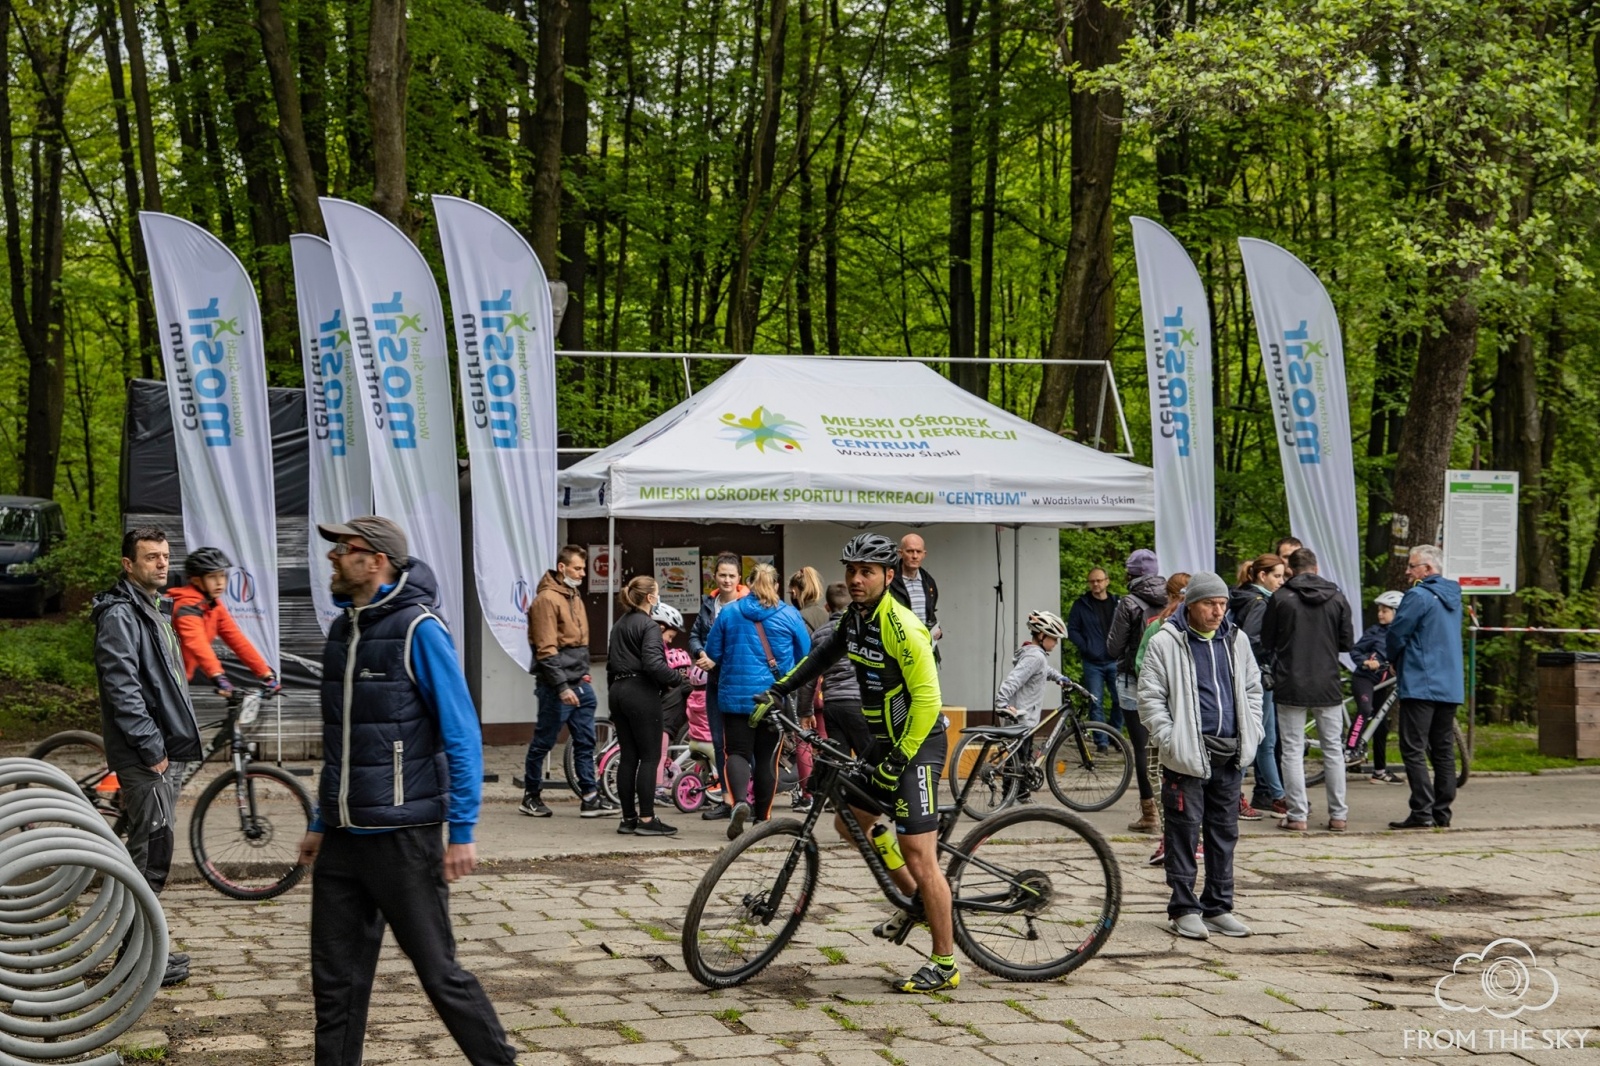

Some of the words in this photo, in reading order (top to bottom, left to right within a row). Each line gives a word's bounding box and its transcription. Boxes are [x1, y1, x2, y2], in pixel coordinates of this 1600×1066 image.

[820, 414, 896, 429] MIEJSKI
[898, 412, 990, 429] OŚRODEK
[825, 426, 902, 440] SPORTU
[919, 427, 1018, 441] REKREACJI
[831, 438, 931, 450] CENTRUM
[836, 448, 916, 459] Wodzisław
[919, 446, 961, 459] Śląski
[639, 486, 701, 501] MIEJSKI
[704, 484, 779, 502] OŚRODEK
[782, 487, 844, 503] SPORTU
[849, 489, 853, 502] I
[857, 490, 934, 505] REKREACJI
[938, 490, 1027, 506] "CENTRUM"
[1031, 497, 1041, 506] w
[1041, 495, 1100, 506] Wodzisławiu
[1100, 494, 1136, 507] Śląskim
[891, 607, 906, 642] HEAD
[916, 764, 930, 817] HEAD
